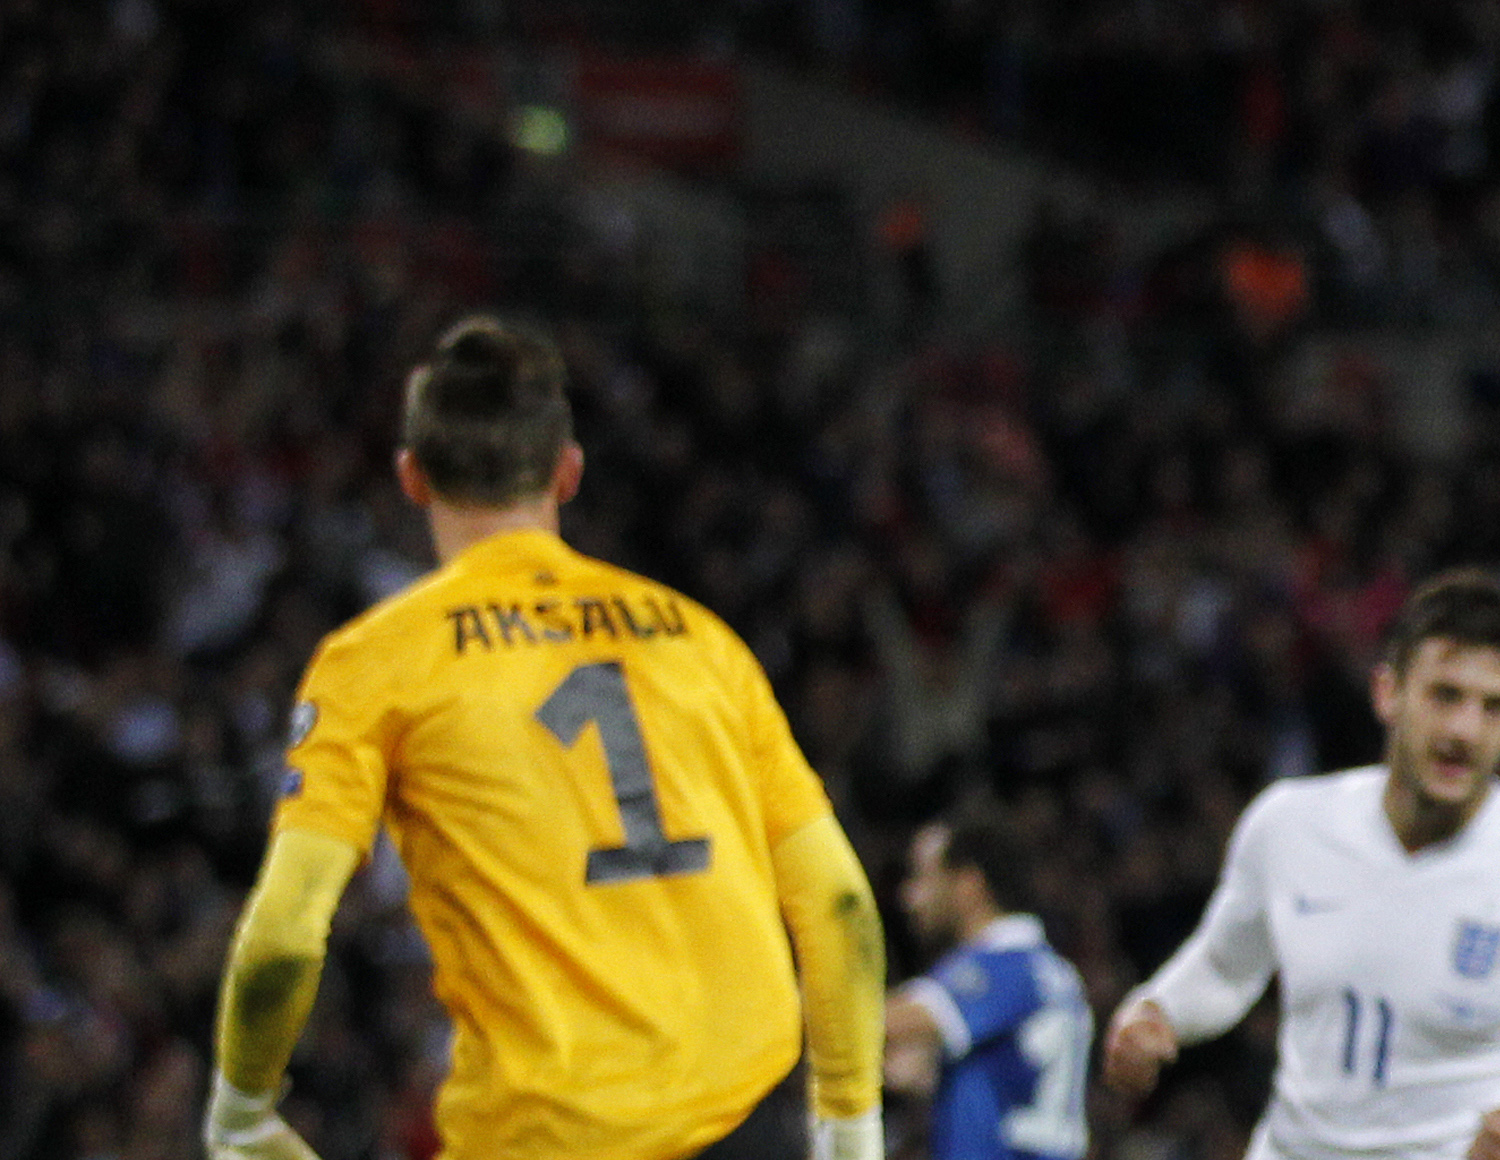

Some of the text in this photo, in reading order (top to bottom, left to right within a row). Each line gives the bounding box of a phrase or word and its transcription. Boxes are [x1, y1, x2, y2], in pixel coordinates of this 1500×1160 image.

[446, 596, 690, 655] AKSALU
[533, 661, 713, 887] 1
[1341, 986, 1396, 1087] 11
